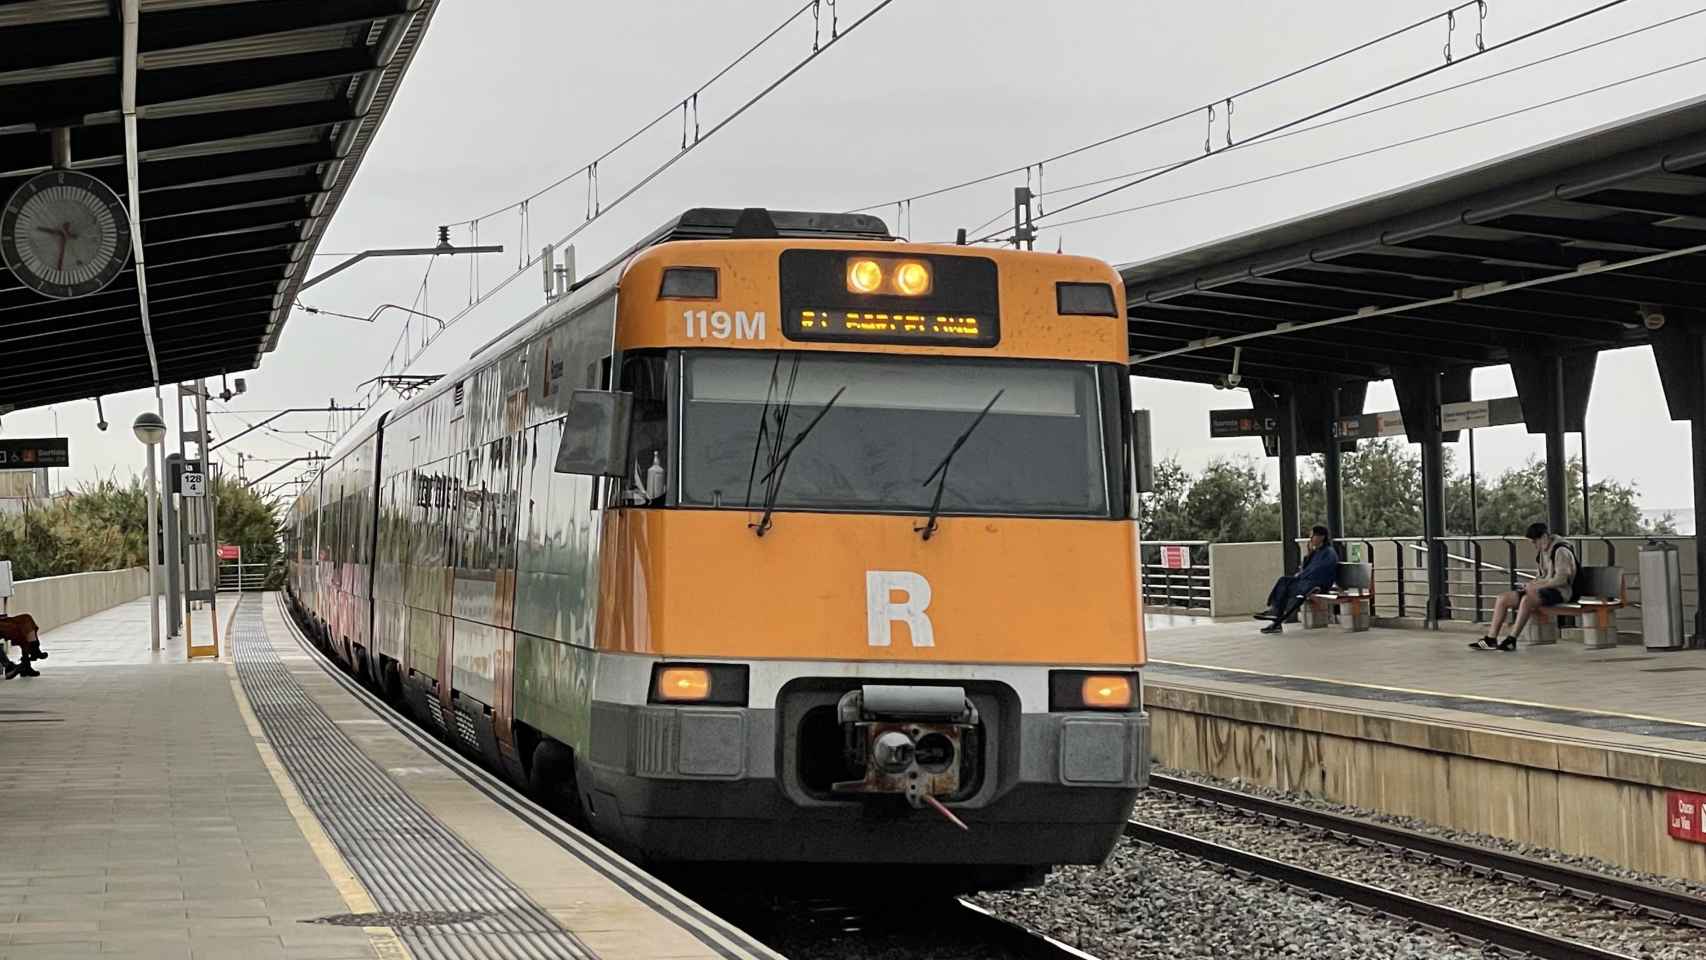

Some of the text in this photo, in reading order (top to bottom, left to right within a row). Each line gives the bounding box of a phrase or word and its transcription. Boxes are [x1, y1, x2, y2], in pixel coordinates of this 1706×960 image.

[684, 311, 766, 340] 119M
[185, 475, 202, 483] 128
[866, 570, 935, 647] R
